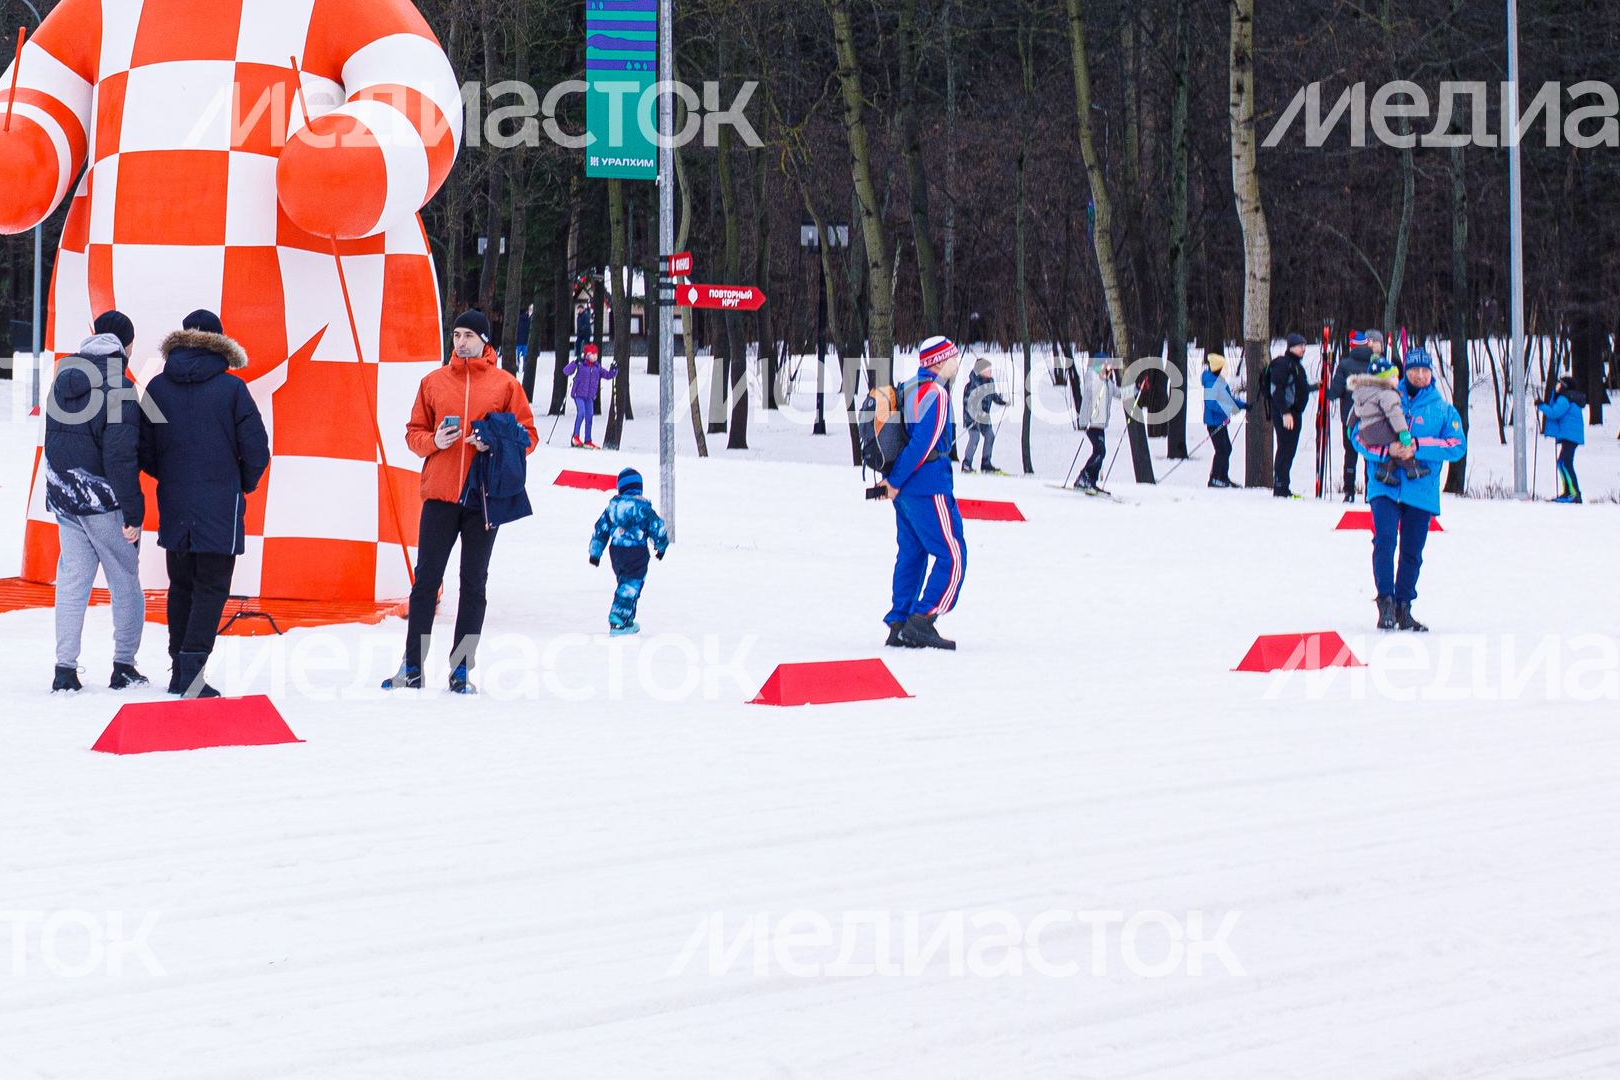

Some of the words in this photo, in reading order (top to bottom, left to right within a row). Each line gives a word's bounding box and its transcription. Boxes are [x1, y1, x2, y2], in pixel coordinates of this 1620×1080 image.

[601, 157, 654, 168] УРАЛХИМ
[708, 289, 753, 300] ПОВТОРНЫЙ
[721, 298, 740, 308] КРУГ
